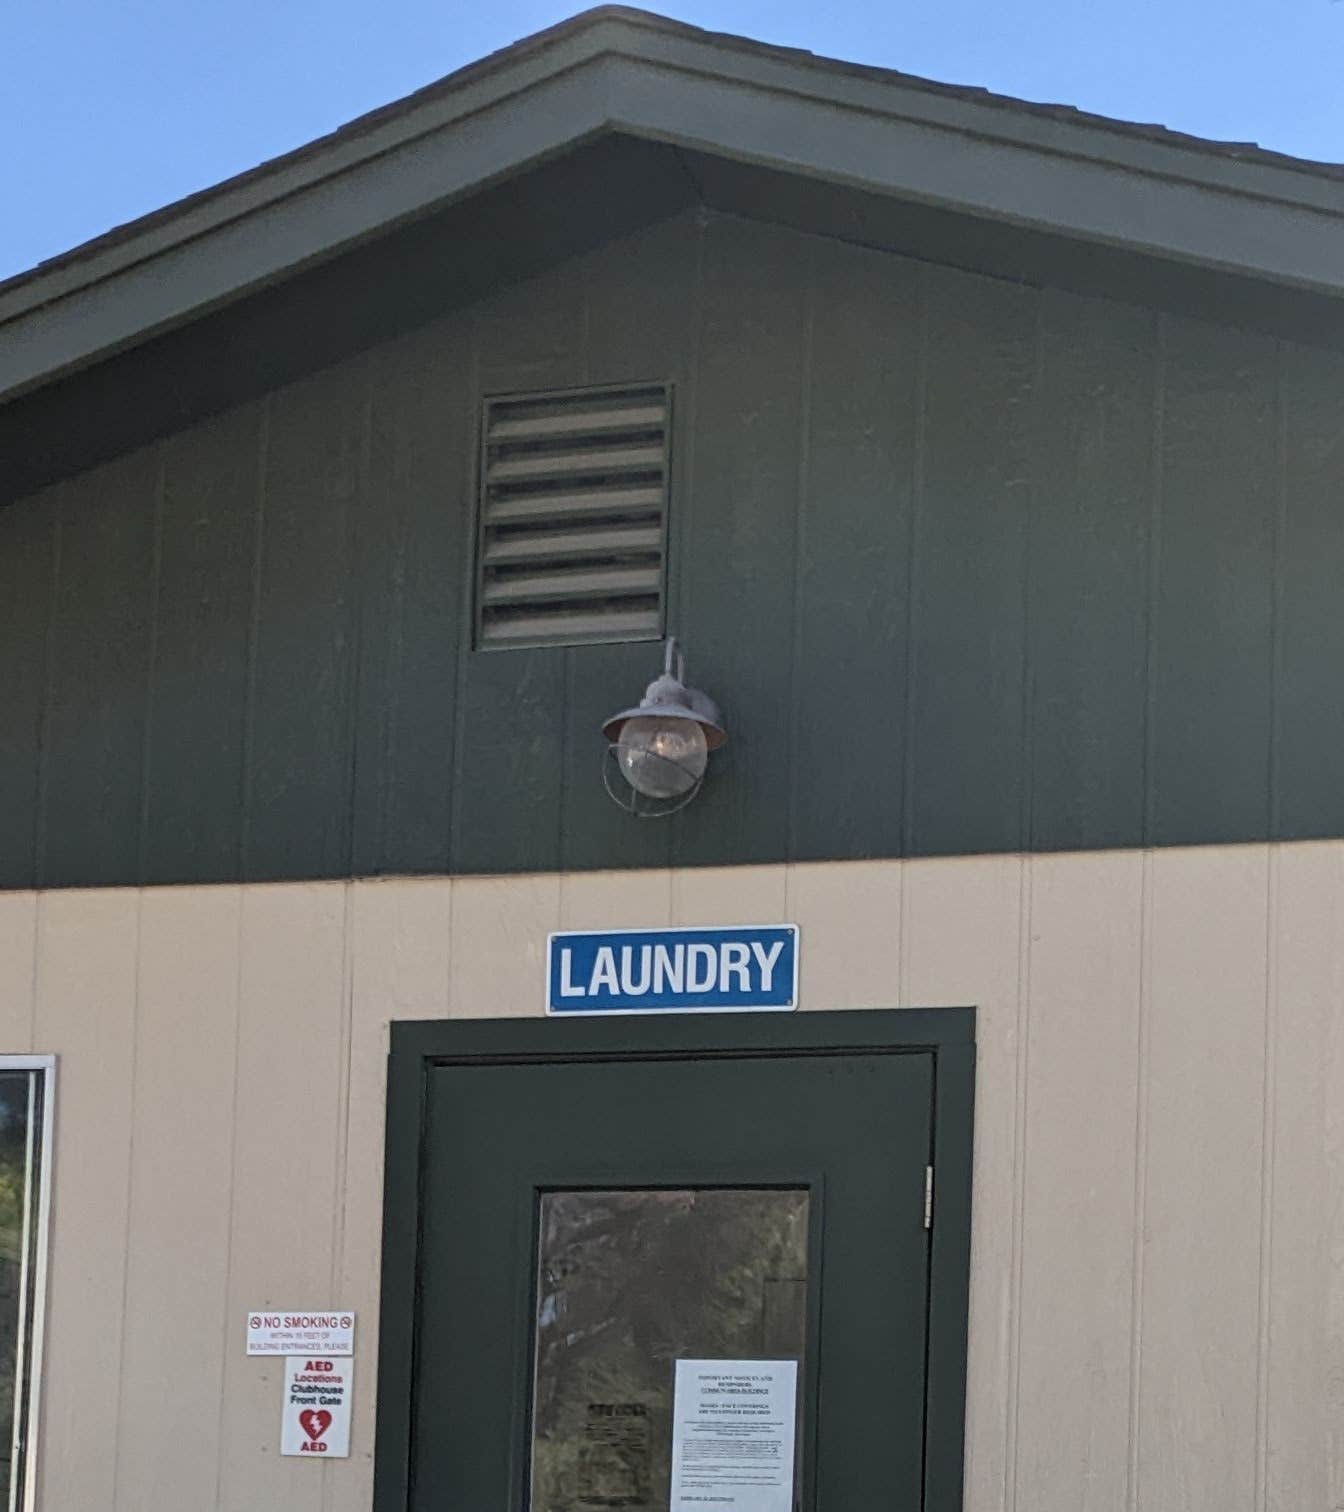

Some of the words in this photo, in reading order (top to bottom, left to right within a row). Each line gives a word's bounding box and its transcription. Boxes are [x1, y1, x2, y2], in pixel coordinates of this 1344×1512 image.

[560, 941, 785, 997] LAUNDRY
[264, 1316, 281, 1329] NO
[284, 1316, 338, 1329] SMOKING
[304, 1360, 334, 1372] AED
[294, 1373, 343, 1384] Locations
[290, 1384, 345, 1395] Clubhouse
[290, 1395, 316, 1406] Front
[319, 1396, 342, 1406] Gate
[300, 1441, 328, 1453] AED
